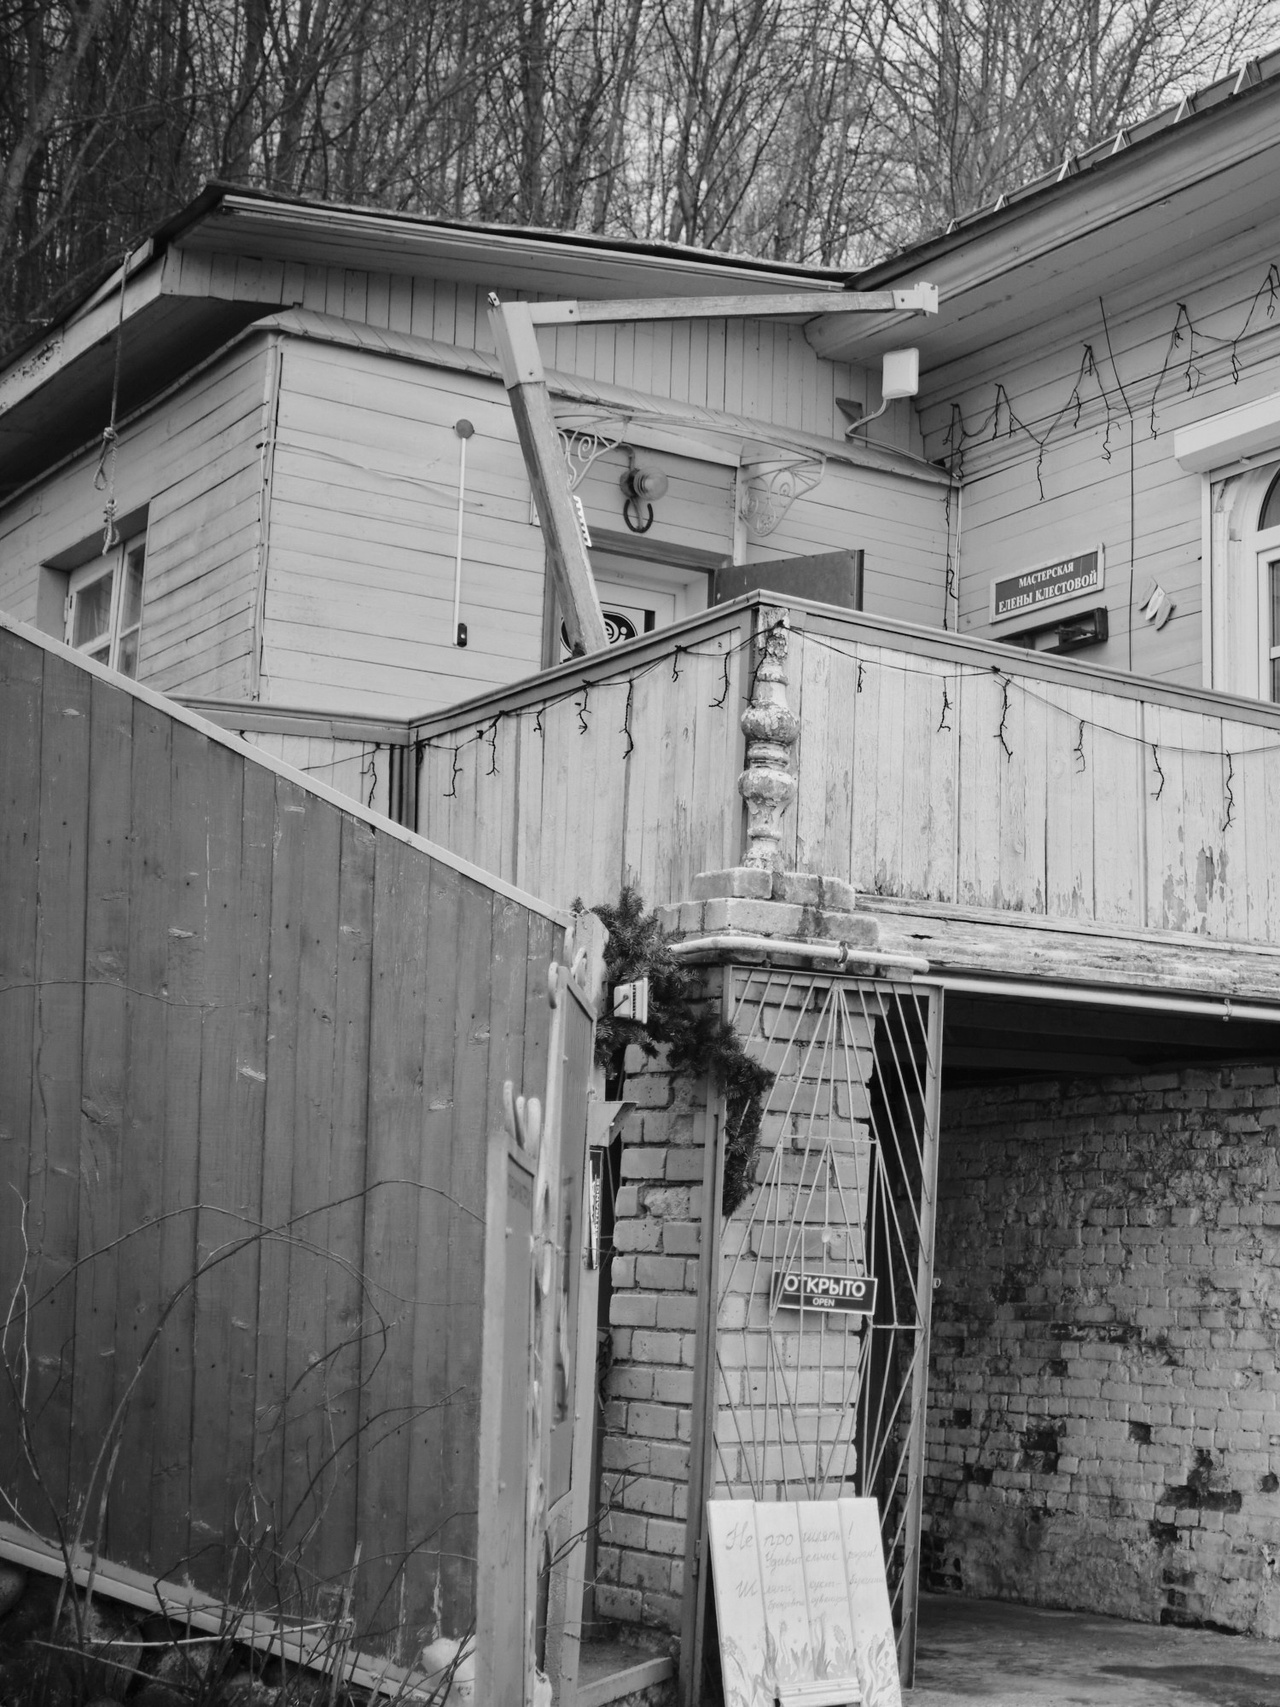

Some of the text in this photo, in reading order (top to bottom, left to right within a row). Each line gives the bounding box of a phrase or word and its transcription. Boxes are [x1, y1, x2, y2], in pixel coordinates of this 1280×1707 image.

[1018, 561, 1074, 588] МАСТЕРСКАЯ
[998, 569, 1097, 613] ЕЛЕНЫ КЛЕСТОВОЙ
[812, 1297, 835, 1307] OPEN
[725, 1521, 753, 1550] Не
